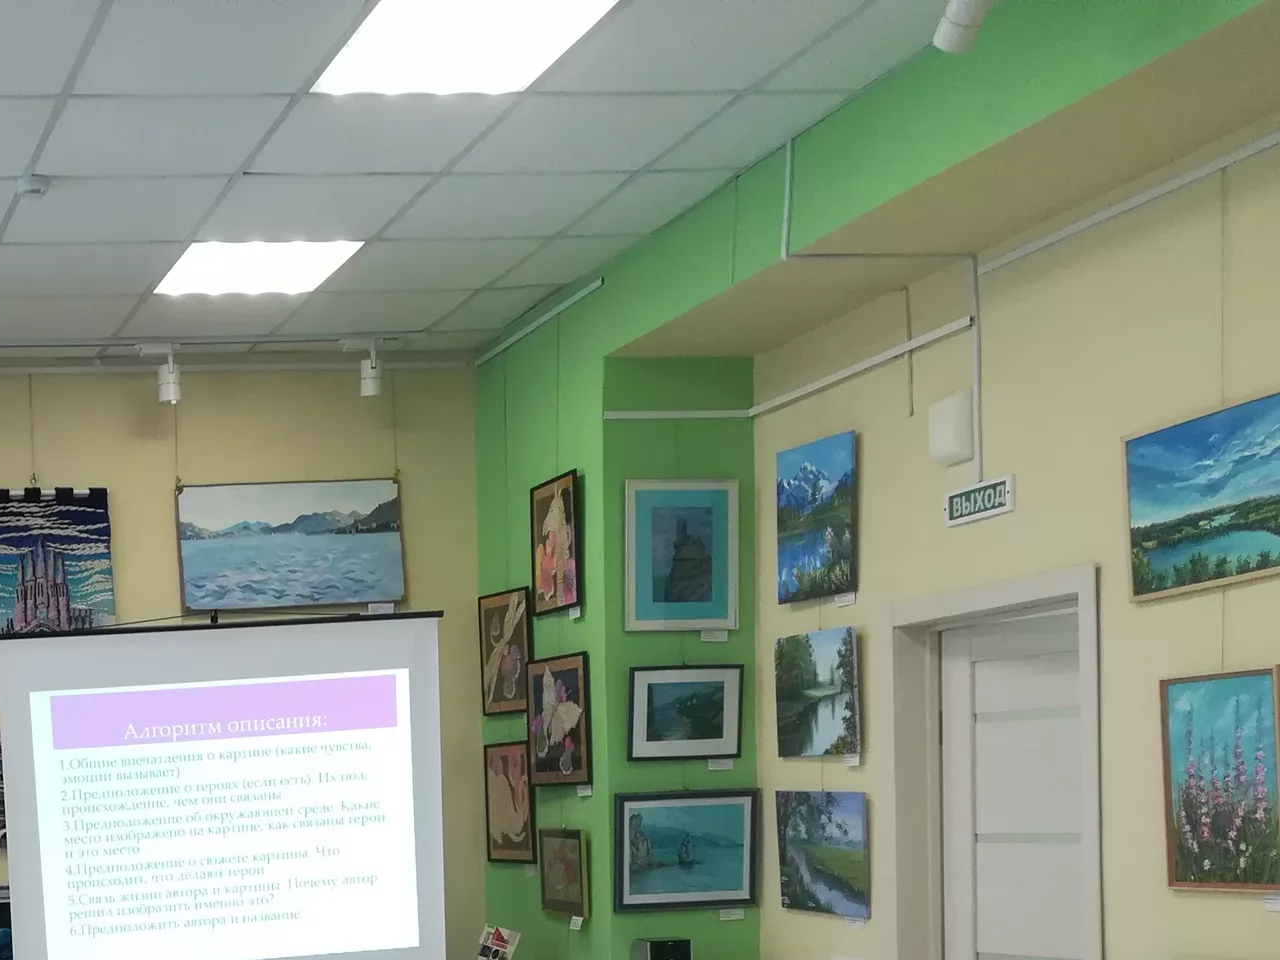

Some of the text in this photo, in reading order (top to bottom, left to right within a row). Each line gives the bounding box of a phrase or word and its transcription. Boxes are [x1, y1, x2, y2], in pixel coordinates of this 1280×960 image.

[952, 485, 1005, 517] ВЫХОД
[123, 715, 327, 741] Алгоритм описания:
[60, 757, 116, 770] 1.Общие
[120, 753, 203, 766] впечатления
[219, 748, 271, 762] картине
[275, 745, 316, 756] (какие
[320, 742, 371, 755] чувства,
[60, 785, 180, 803] 2.Предположение
[196, 781, 238, 794] героях
[242, 778, 276, 789] (если
[318, 771, 335, 783] Их
[340, 772, 367, 781] пол,
[61, 765, 180, 784] эмоции вызывает)
[62, 799, 169, 817] происхождение,
[173, 797, 197, 806] чем
[201, 795, 226, 804] они
[62, 815, 182, 833] 3.Предположение
[185, 811, 201, 822] об
[340, 800, 379, 811] Какие
[64, 813, 385, 845] место изображено на картине, как связаны герои
[65, 859, 184, 878] 4.Предположение
[199, 855, 248, 866] сюжете
[315, 846, 339, 856] Что
[77, 848, 98, 857] это
[103, 845, 140, 855] место
[68, 893, 115, 905] 5.Связь
[119, 891, 161, 901] жизни
[165, 888, 207, 900] автора
[288, 877, 335, 889] Почему
[342, 874, 377, 886] автор
[151, 873, 173, 882] что
[176, 869, 223, 881] делают
[69, 892, 274, 923] решил изобразить именно это?
[69, 920, 179, 938] 6.Предположить
[183, 917, 225, 929] автора
